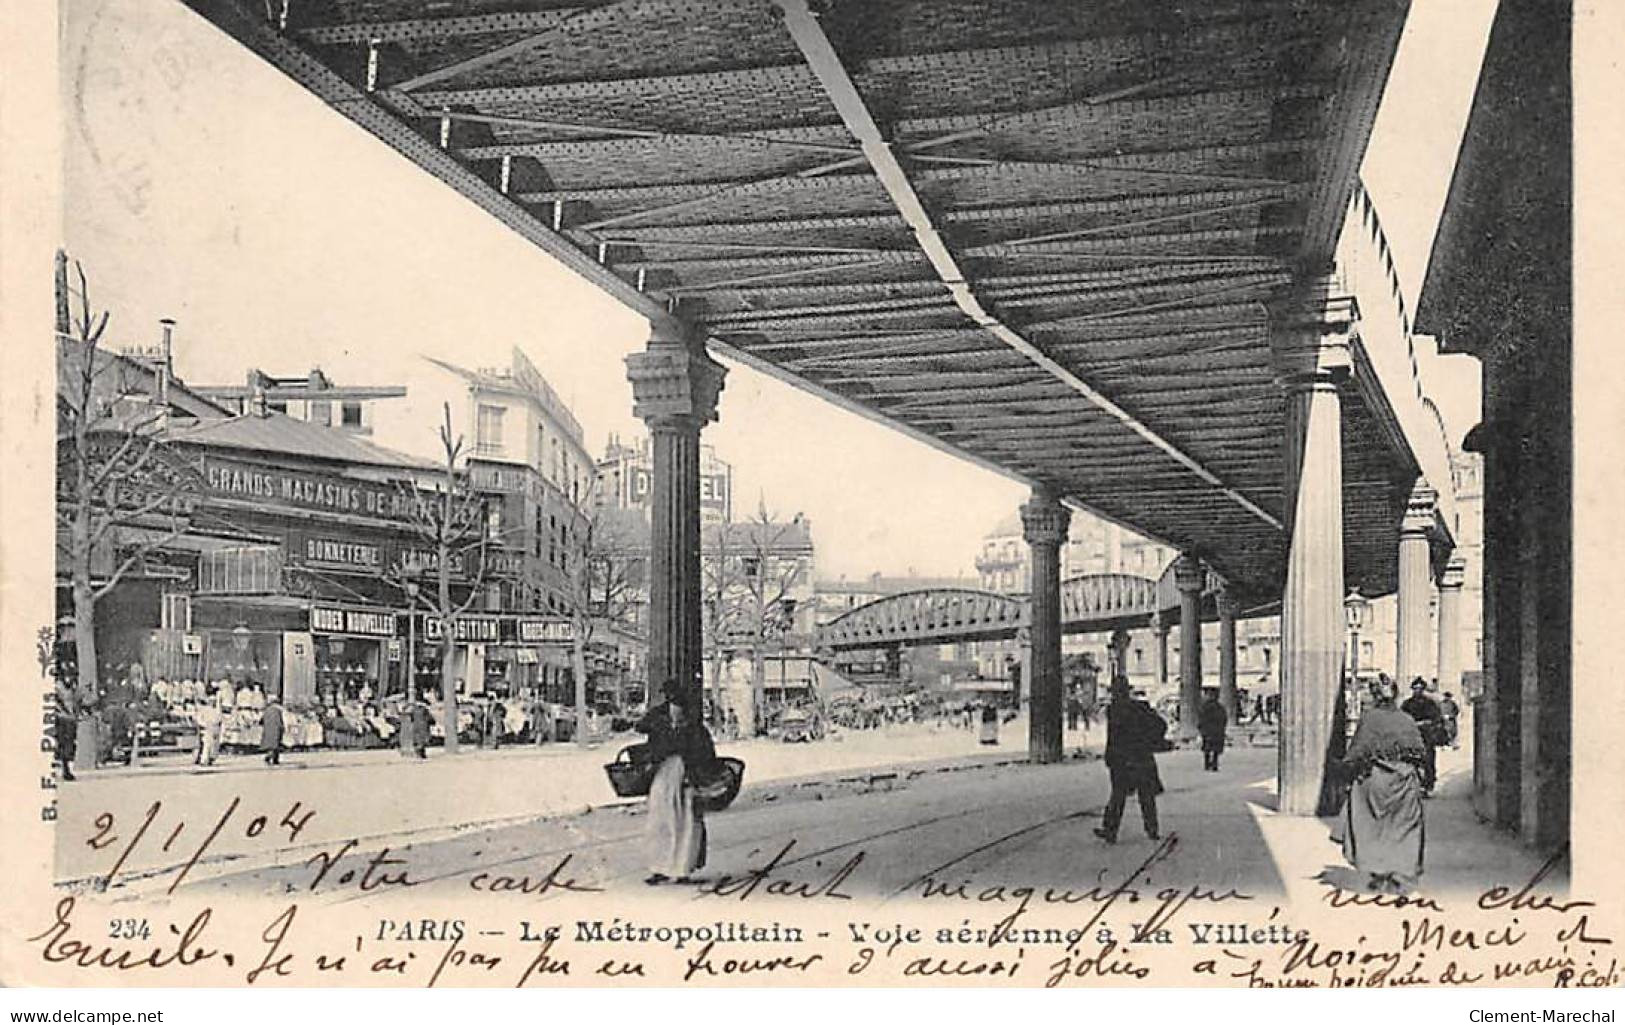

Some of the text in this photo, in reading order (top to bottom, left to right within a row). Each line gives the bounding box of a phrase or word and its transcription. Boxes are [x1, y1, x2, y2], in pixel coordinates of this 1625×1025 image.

[208, 466, 274, 498] GRANDS
[280, 475, 360, 511] MAGASINS
[366, 489, 386, 514] DE
[306, 539, 379, 565] BONNETERIE
[470, 854, 606, 893] carte
[1323, 886, 1445, 912] mon
[246, 903, 294, 985] Je
[427, 935, 503, 988] pas
[684, 942, 823, 981] trouver
[1402, 917, 1527, 951] Merci
[1438, 961, 1484, 985] de
